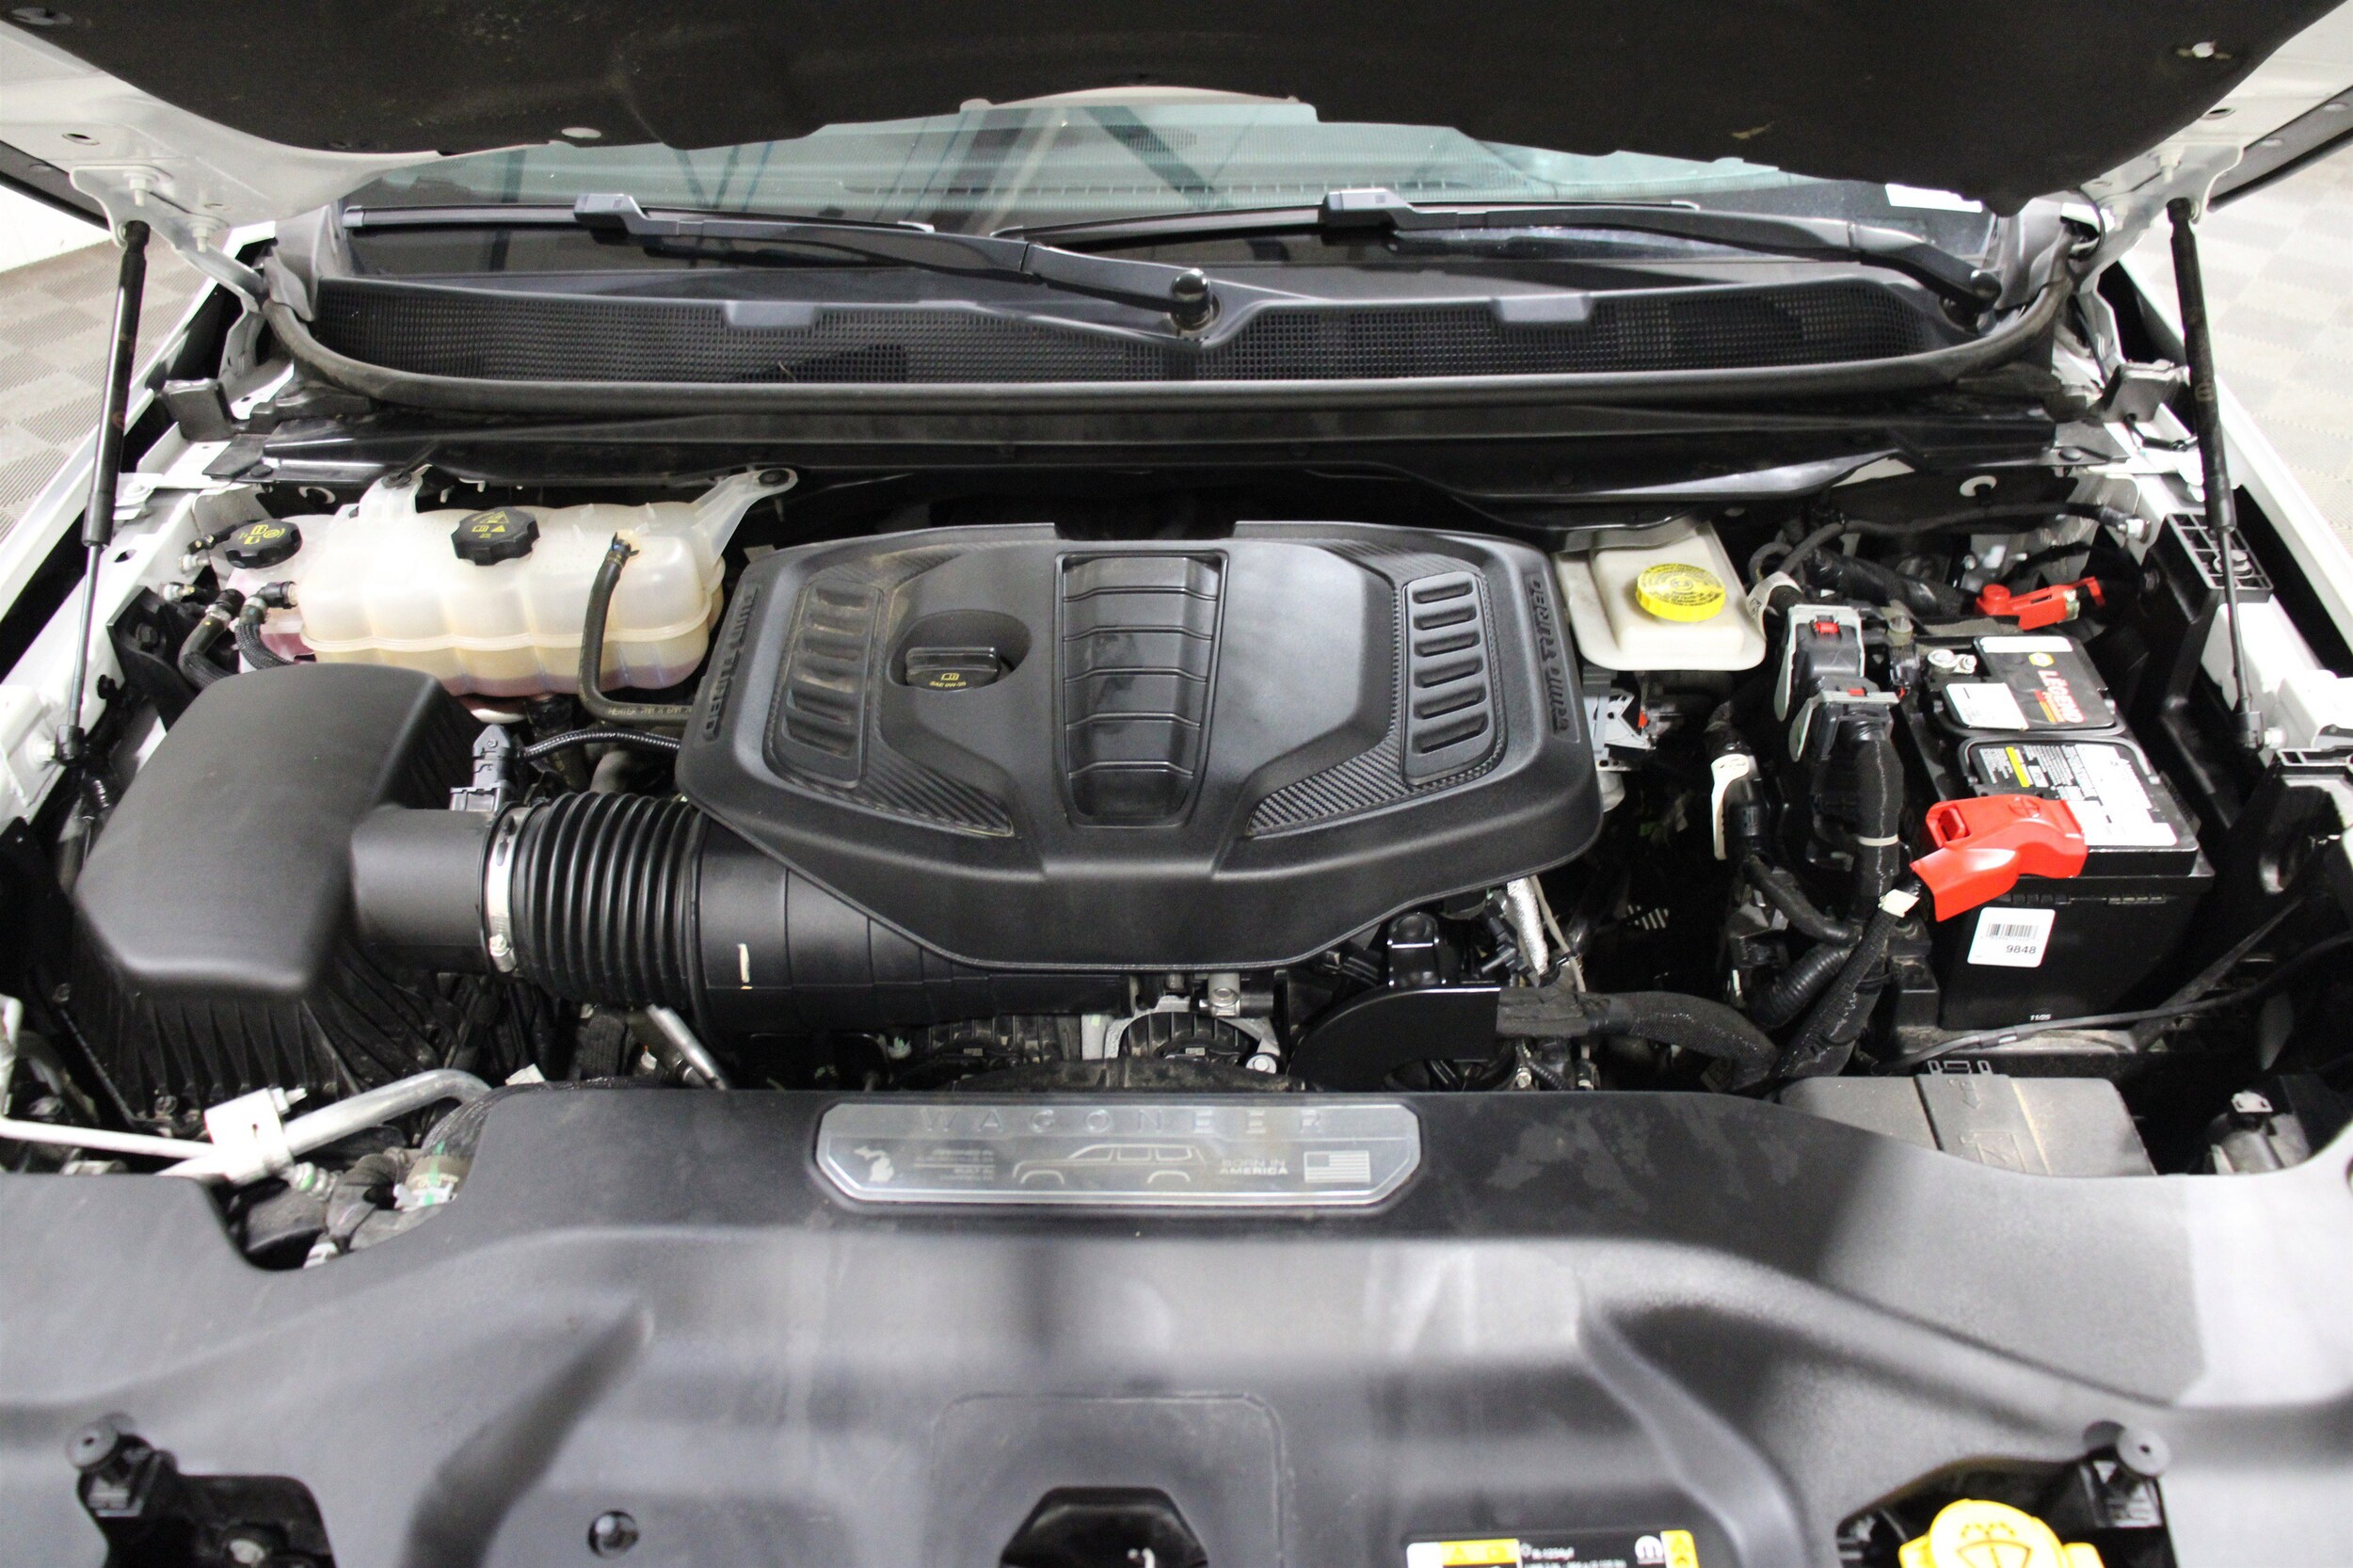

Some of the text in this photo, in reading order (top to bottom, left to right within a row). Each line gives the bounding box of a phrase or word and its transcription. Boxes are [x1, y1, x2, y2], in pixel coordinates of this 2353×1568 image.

[2006, 944, 2037, 954] 9848
[919, 1107, 1323, 1133] WAGONEER
[1222, 1158, 1286, 1167] BORN IN
[1219, 1166, 1289, 1176] AMERICA
